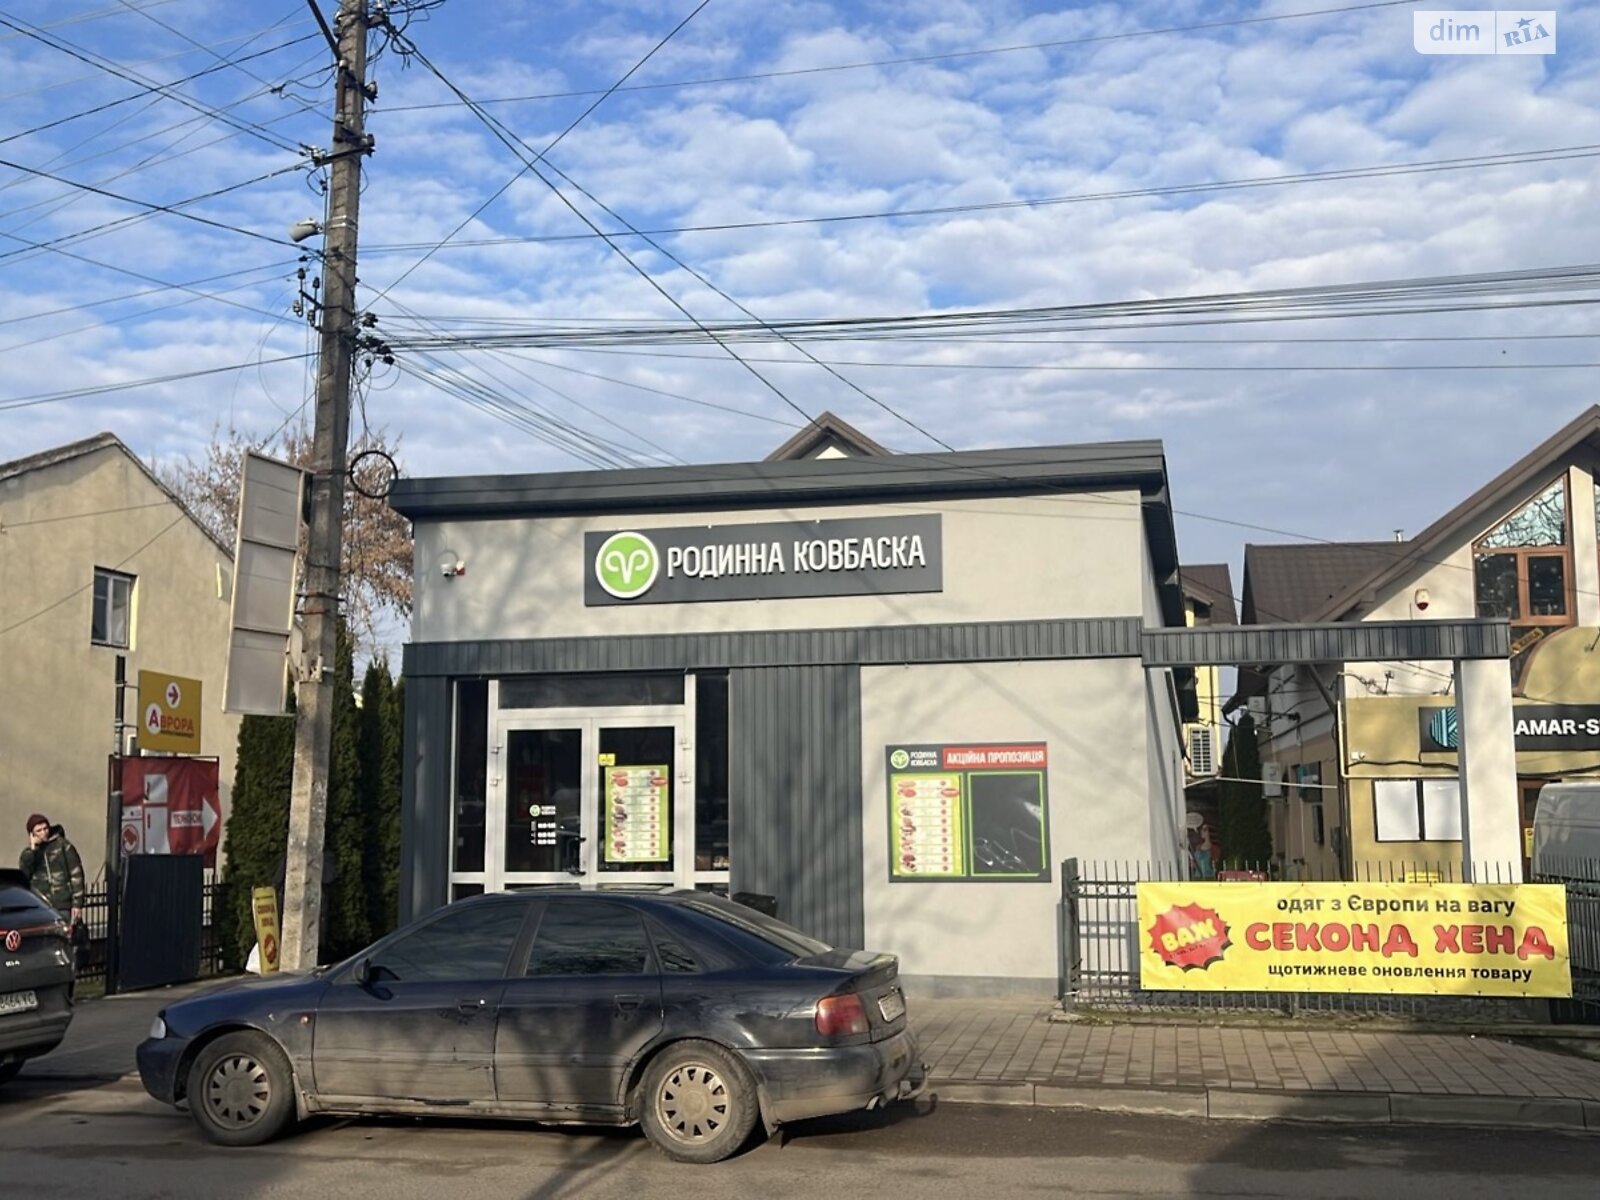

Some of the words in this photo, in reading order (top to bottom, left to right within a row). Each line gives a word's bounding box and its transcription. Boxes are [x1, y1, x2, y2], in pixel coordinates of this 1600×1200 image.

[667, 542, 785, 579] РОДИННА
[793, 535, 927, 572] КОВБАСКА
[1514, 718, 1600, 735] AMAR-S
[1277, 898, 1324, 914] одяг
[1331, 898, 1341, 911] з
[1347, 894, 1429, 916] Європи
[1435, 899, 1461, 913] на
[1468, 900, 1516, 917] вагу
[1245, 922, 1419, 959] СЕКОНД
[1433, 924, 1555, 961] ХЕНД
[1268, 964, 1367, 977] щотижневе
[1372, 966, 1466, 979] оновлення
[1470, 969, 1532, 983] товару
